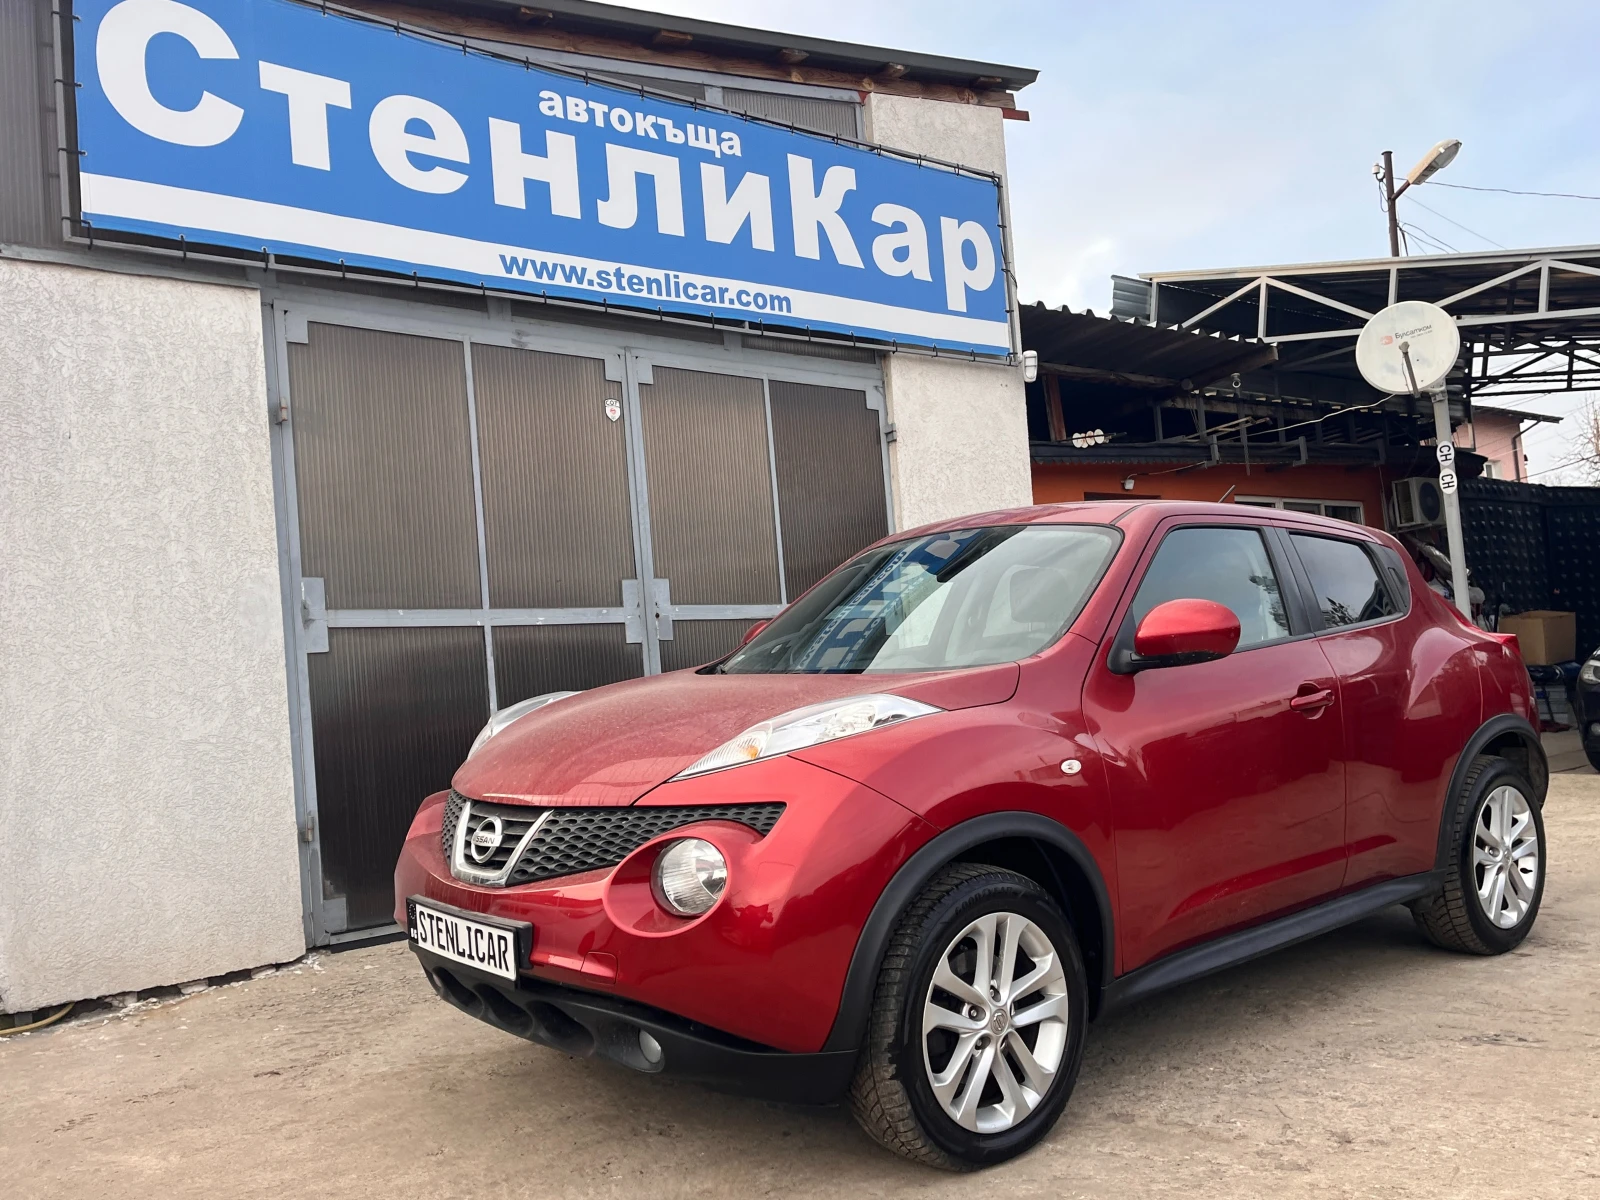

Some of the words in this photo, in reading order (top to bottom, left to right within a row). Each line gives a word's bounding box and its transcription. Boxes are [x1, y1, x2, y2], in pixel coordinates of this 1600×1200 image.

[539, 90, 742, 158] автокъща
[96, 0, 996, 312] СтенлиКар
[499, 254, 792, 313] www.stenlicar.com
[1439, 445, 1452, 462] CH
[1441, 473, 1455, 489] CH
[472, 834, 495, 845] ISSAN
[418, 910, 509, 972] STENLICAR
